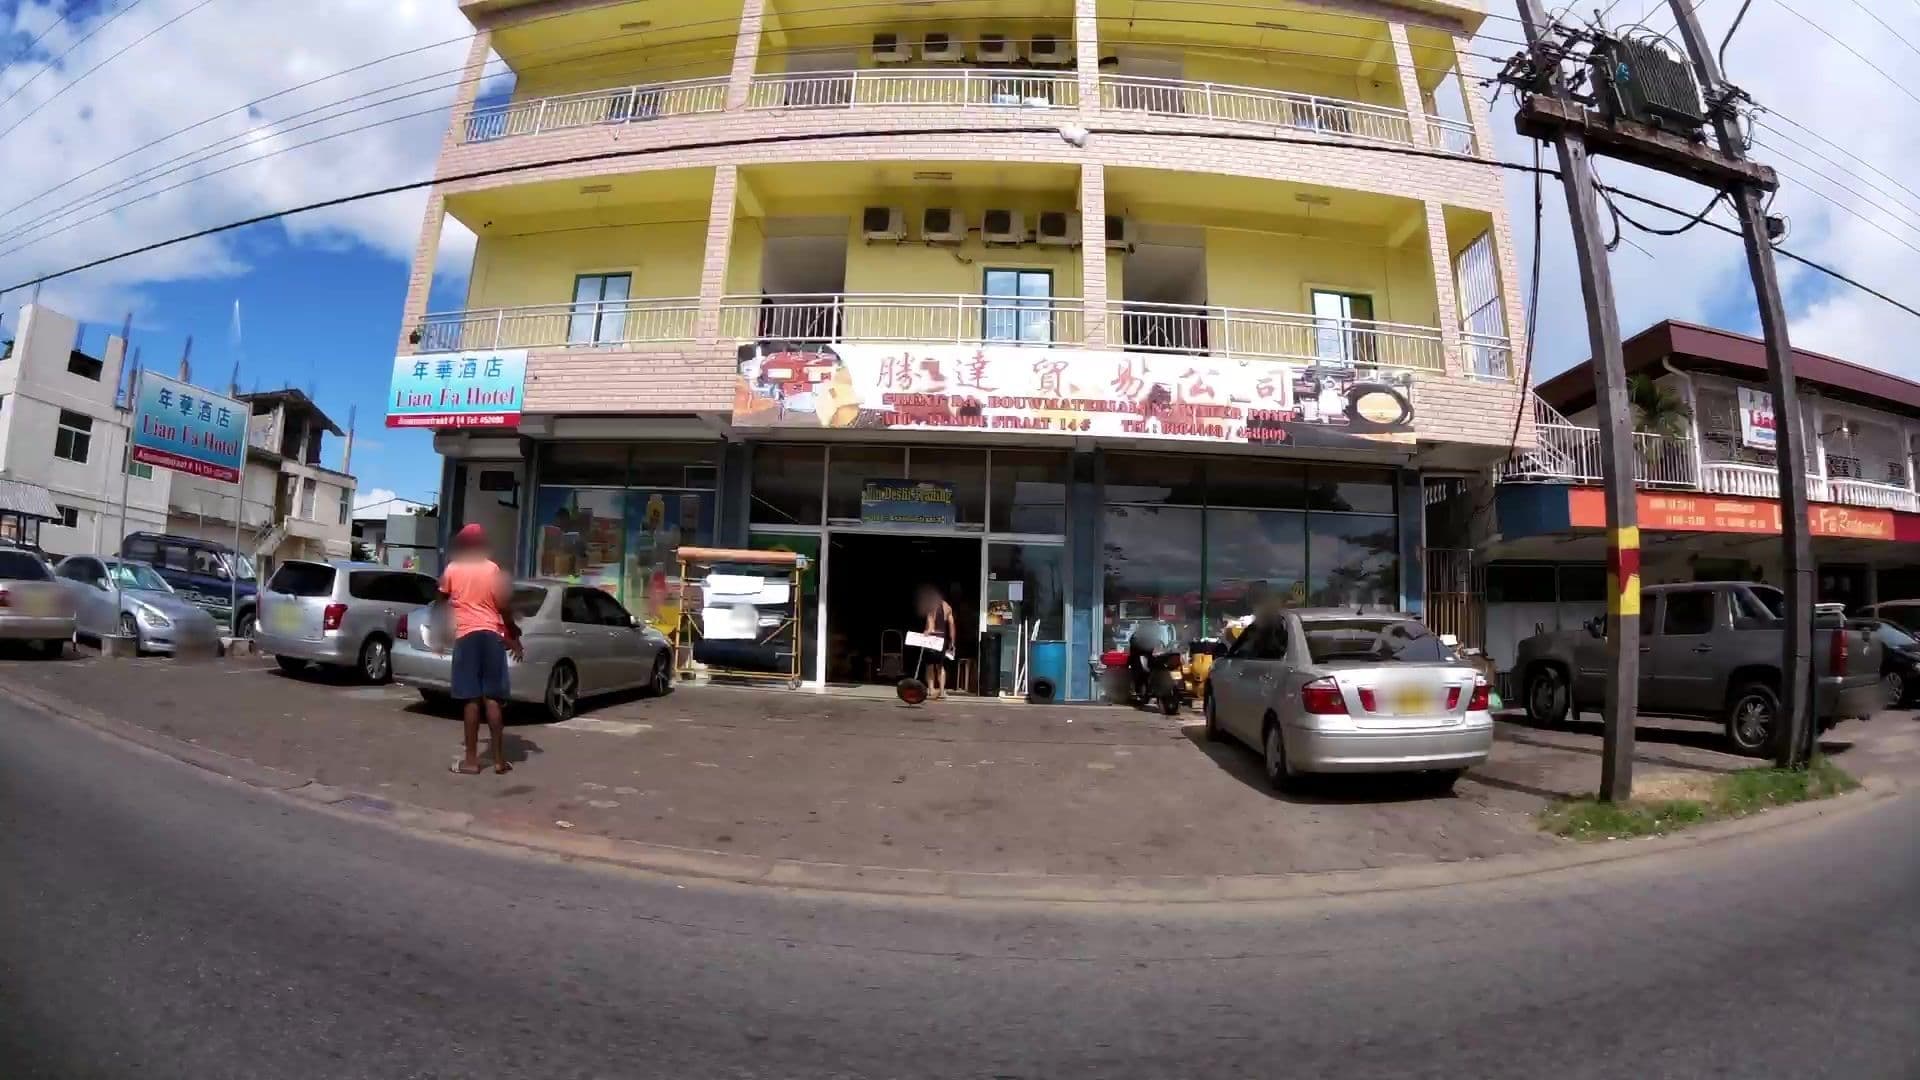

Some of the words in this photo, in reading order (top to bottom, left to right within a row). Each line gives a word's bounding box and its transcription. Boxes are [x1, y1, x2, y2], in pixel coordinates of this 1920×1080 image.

[413, 357, 504, 380] 年華酒店
[158, 387, 230, 429] 年華酒店
[396, 390, 432, 408] Lian
[440, 387, 460, 406] Fa
[467, 385, 515, 405] Hotel
[143, 414, 176, 441] Lian
